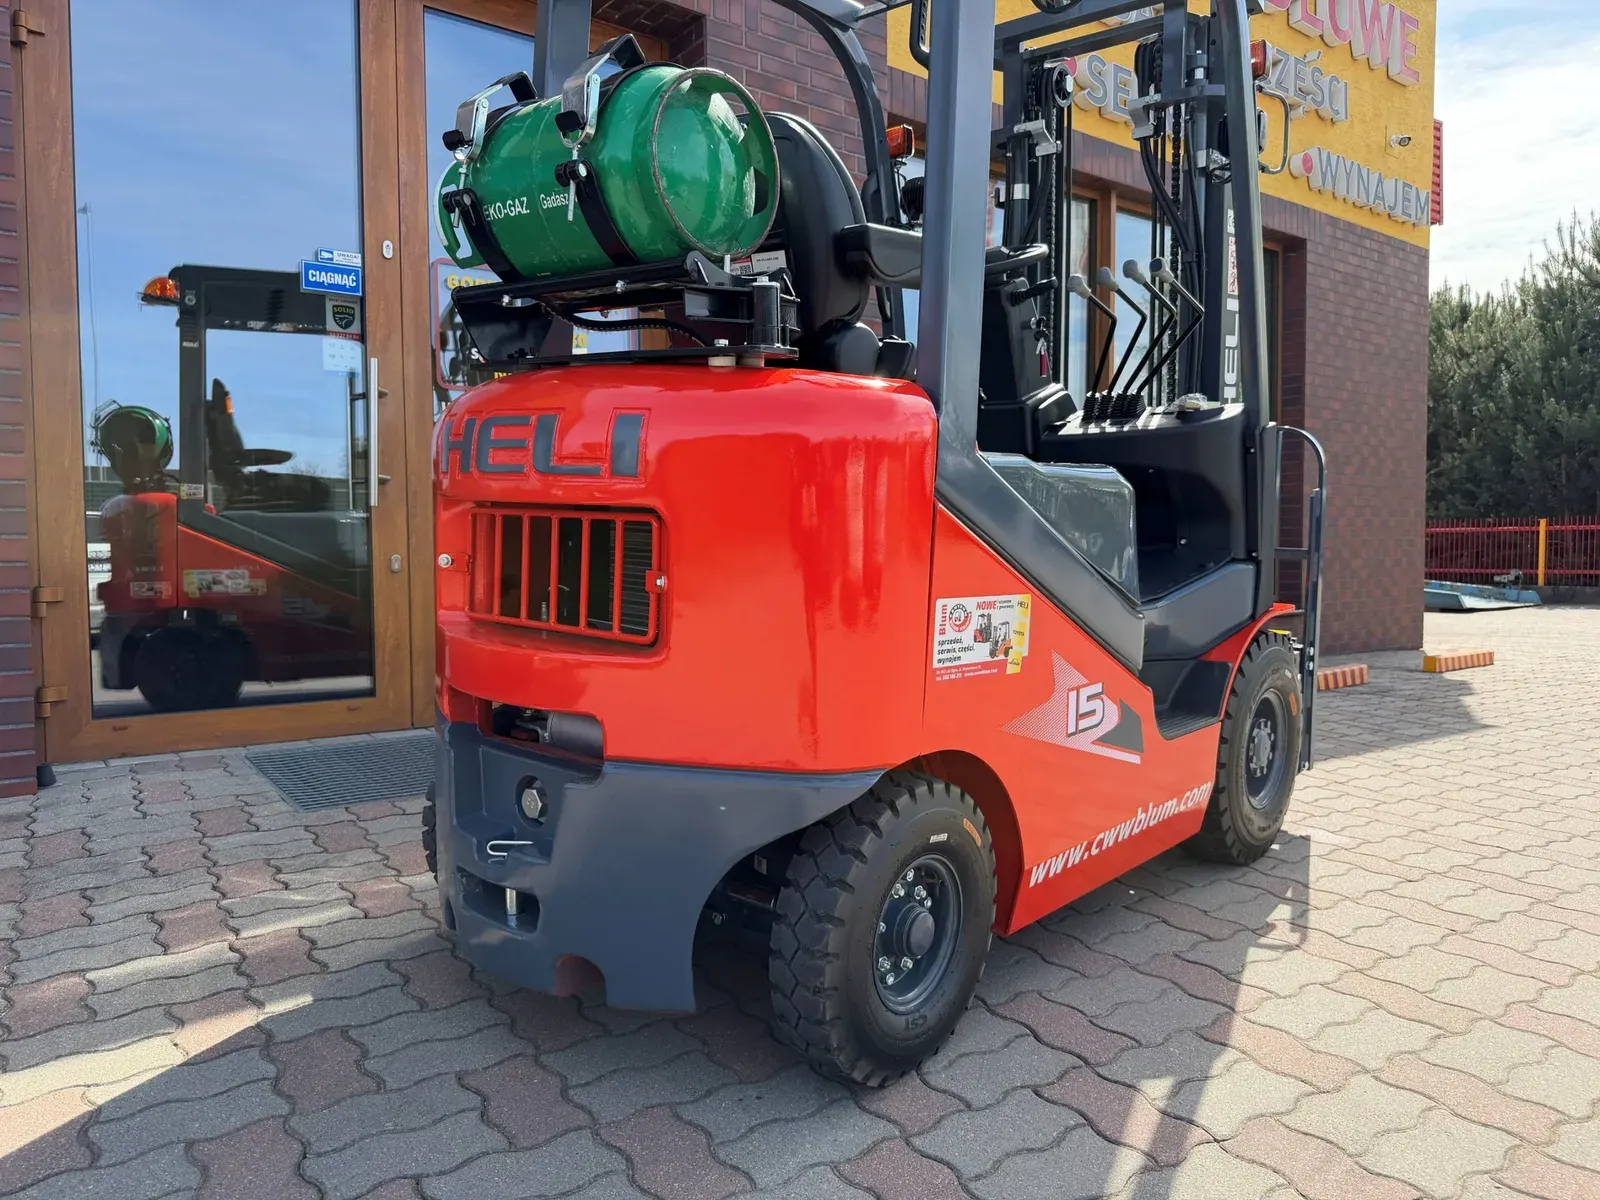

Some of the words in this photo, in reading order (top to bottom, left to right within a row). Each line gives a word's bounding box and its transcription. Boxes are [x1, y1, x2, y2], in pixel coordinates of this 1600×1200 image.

[1262, 47, 1348, 121] ZĘŚCI
[1317, 146, 1430, 226] WYNAJEM
[540, 191, 577, 209] Gadasz
[308, 269, 357, 288] CIĄGNĄĆ
[333, 306, 354, 314] SOLID
[441, 413, 645, 478] HELI
[976, 600, 998, 611] NOWE
[1017, 600, 1029, 609] HELI
[939, 604, 948, 636] Blum
[937, 635, 964, 647] sprzedaż,
[937, 655, 962, 666] wynajem
[1067, 682, 1104, 737] 15
[1029, 781, 1212, 888] www.cwwblum.com
